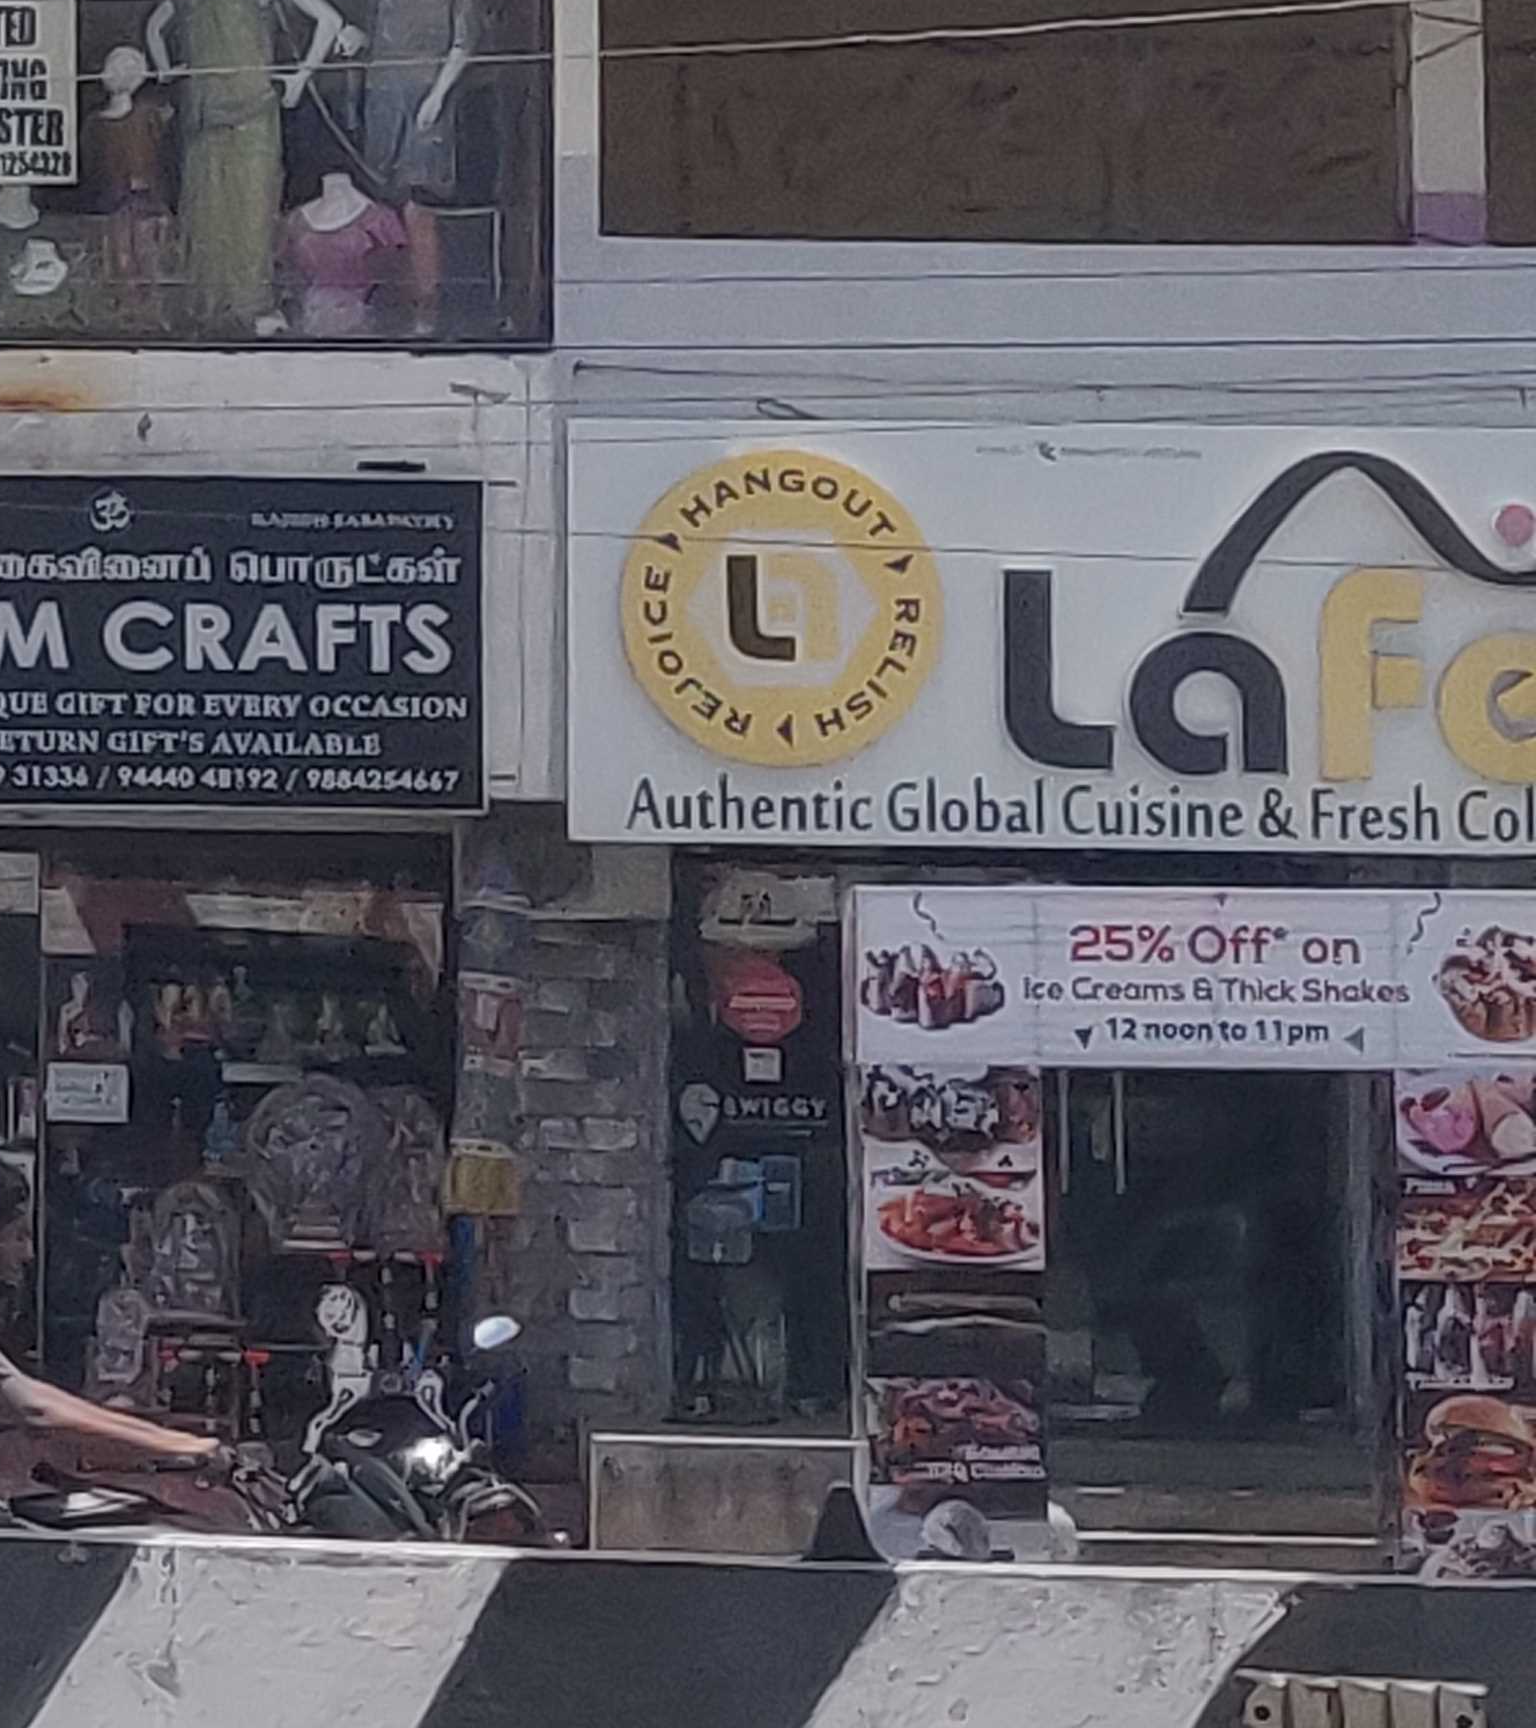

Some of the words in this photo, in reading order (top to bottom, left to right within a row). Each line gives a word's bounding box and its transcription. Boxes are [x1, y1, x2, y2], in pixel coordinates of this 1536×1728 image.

[679, 468, 897, 538] HANGOUT
[102, 600, 455, 674] CRAFTS
[643, 565, 753, 738] REJOICE
[813, 597, 922, 737] RELISH
[54, 692, 129, 717] GIFT
[134, 693, 197, 718] FOR
[203, 693, 302, 719] EVERY
[308, 694, 469, 721] OCCASION
[106, 730, 206, 755] GIFT'S
[211, 731, 382, 757] AVAILABLE
[627, 777, 874, 832] Authentic
[887, 779, 1046, 836] Global
[1057, 783, 1244, 839] Cuisine
[1258, 786, 1299, 841] &
[1310, 783, 1441, 842] Fresh
[1069, 925, 1175, 966] 25%
[1302, 932, 1361, 965] on
[1024, 977, 1065, 1003] Ice
[1071, 978, 1186, 1004] Creams
[1219, 978, 1296, 1004] Thick
[1301, 978, 1411, 1005] Shakes
[1107, 1018, 1137, 1041] 12
[1143, 1020, 1213, 1042] noon
[1218, 1019, 1247, 1043] to
[1255, 1019, 1330, 1045] 11pm
